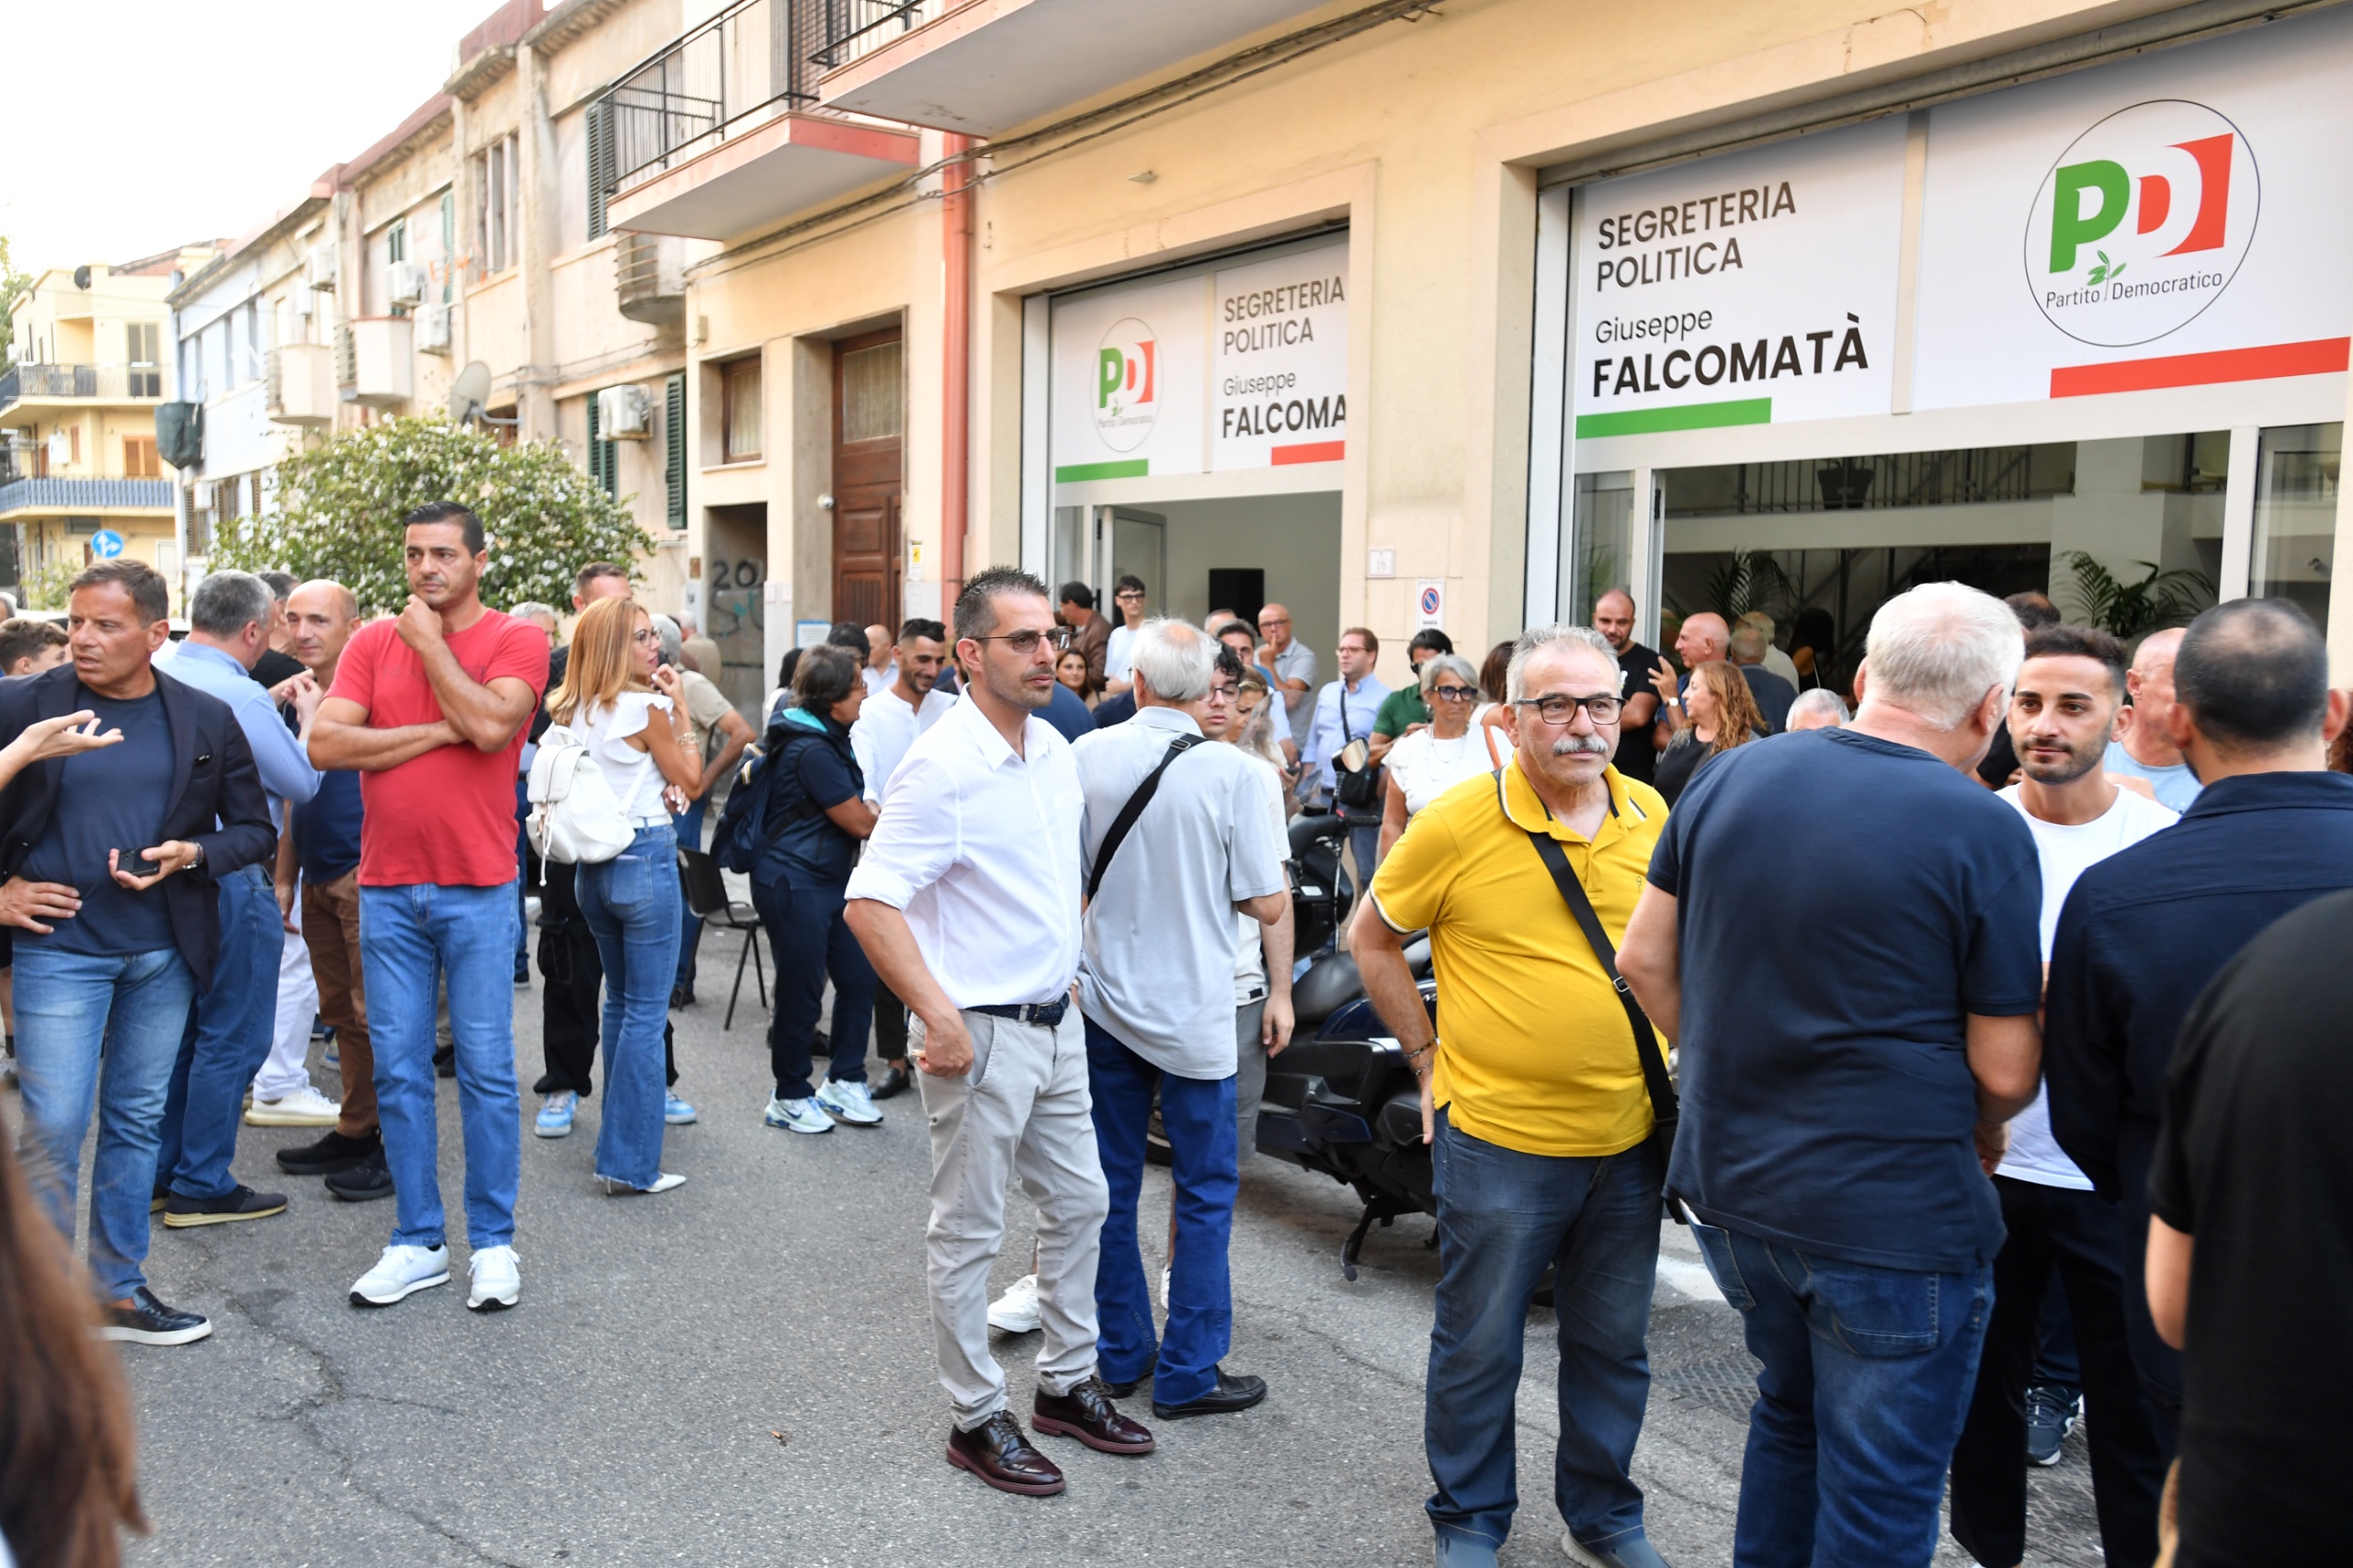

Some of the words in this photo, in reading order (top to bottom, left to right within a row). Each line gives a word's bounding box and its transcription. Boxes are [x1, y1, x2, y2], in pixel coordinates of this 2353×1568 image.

[1597, 181, 1796, 250] SEGRETERIA
[2049, 132, 2234, 274] PD
[1597, 237, 1743, 292] POLITICA
[1224, 276, 1346, 323] SEGRETERIA
[2046, 287, 2101, 309] Partito
[2111, 270, 2223, 301] Democratico
[1224, 317, 1313, 356] POLITICA
[1595, 310, 1712, 344] Giuseppe
[1099, 340, 1154, 409] PD
[1592, 312, 1869, 398] FALCOMATÀ
[1223, 371, 1296, 397] Giuseppe
[1222, 393, 1347, 439] FALCOMA
